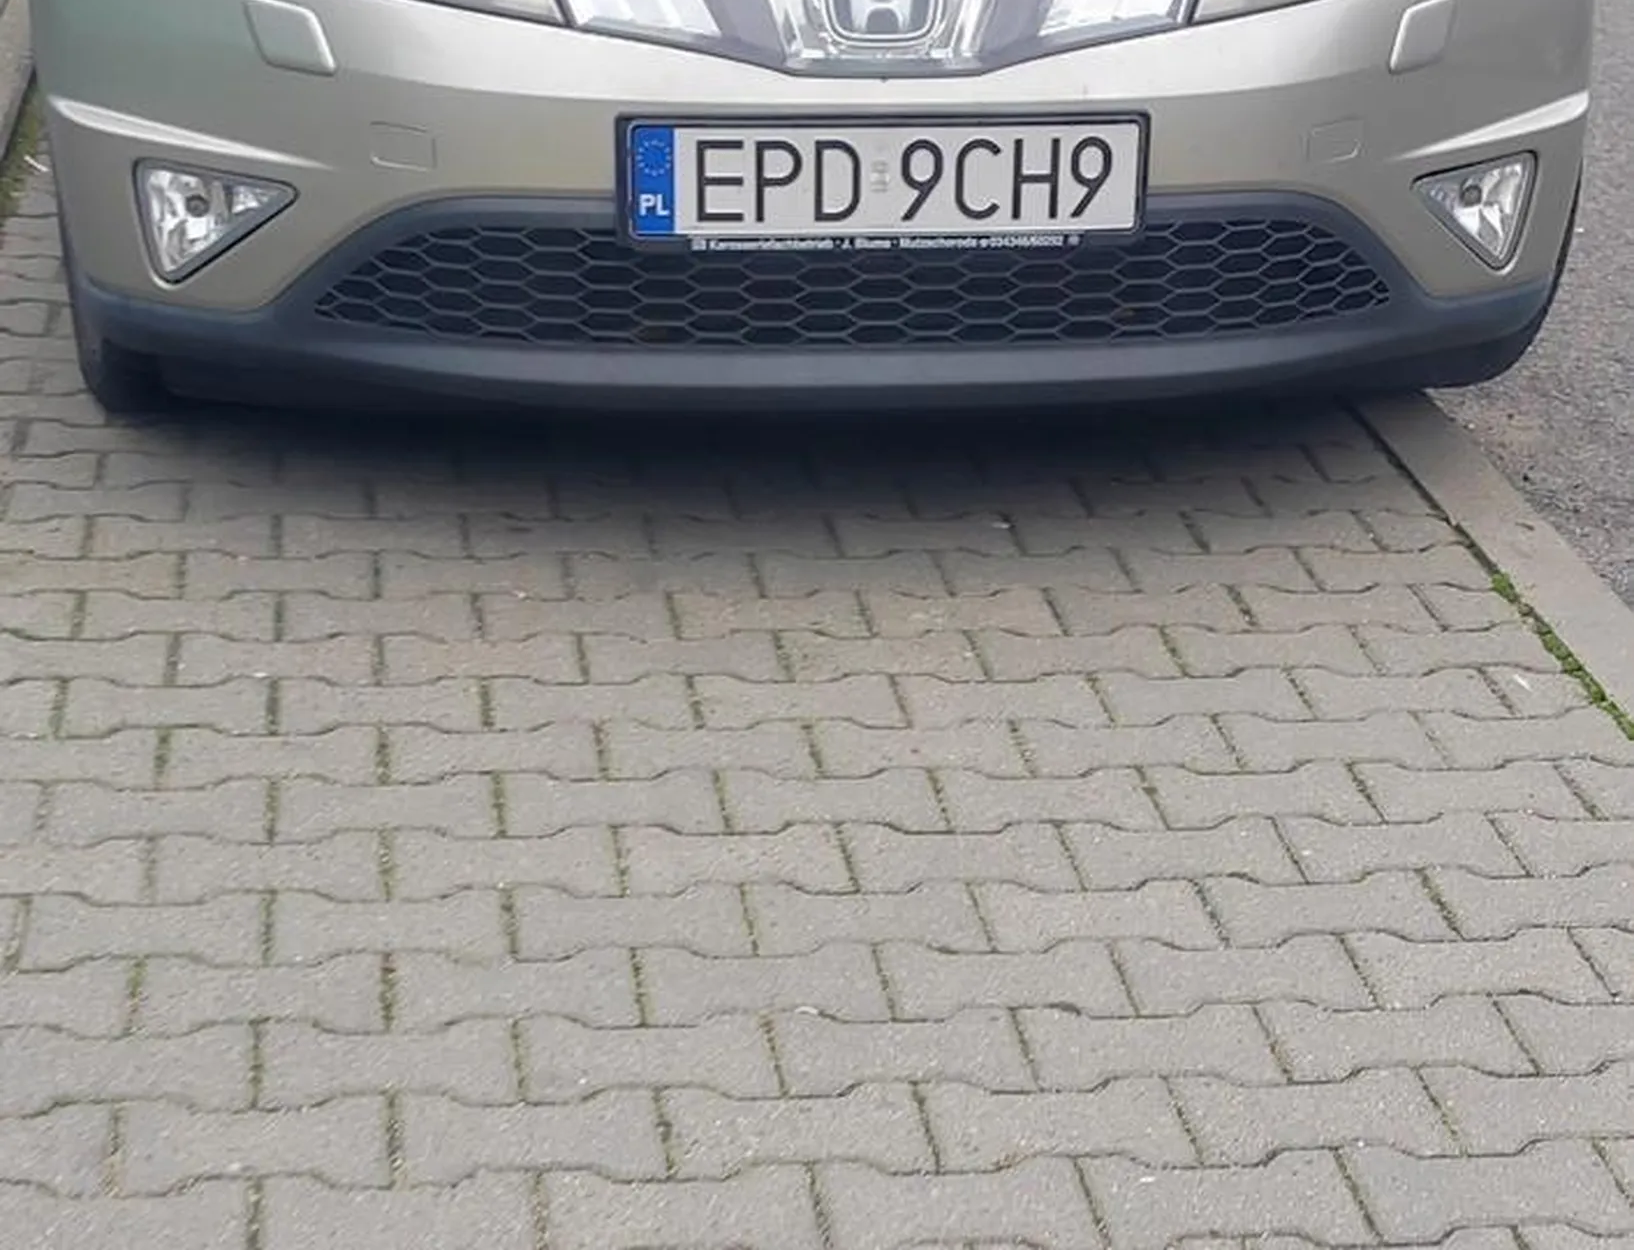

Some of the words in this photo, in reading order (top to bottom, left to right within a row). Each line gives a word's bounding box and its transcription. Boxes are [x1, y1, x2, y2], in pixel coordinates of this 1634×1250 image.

[639, 194, 671, 217] PL
[697, 139, 862, 223] EPD
[901, 136, 1113, 222] 9CH9
